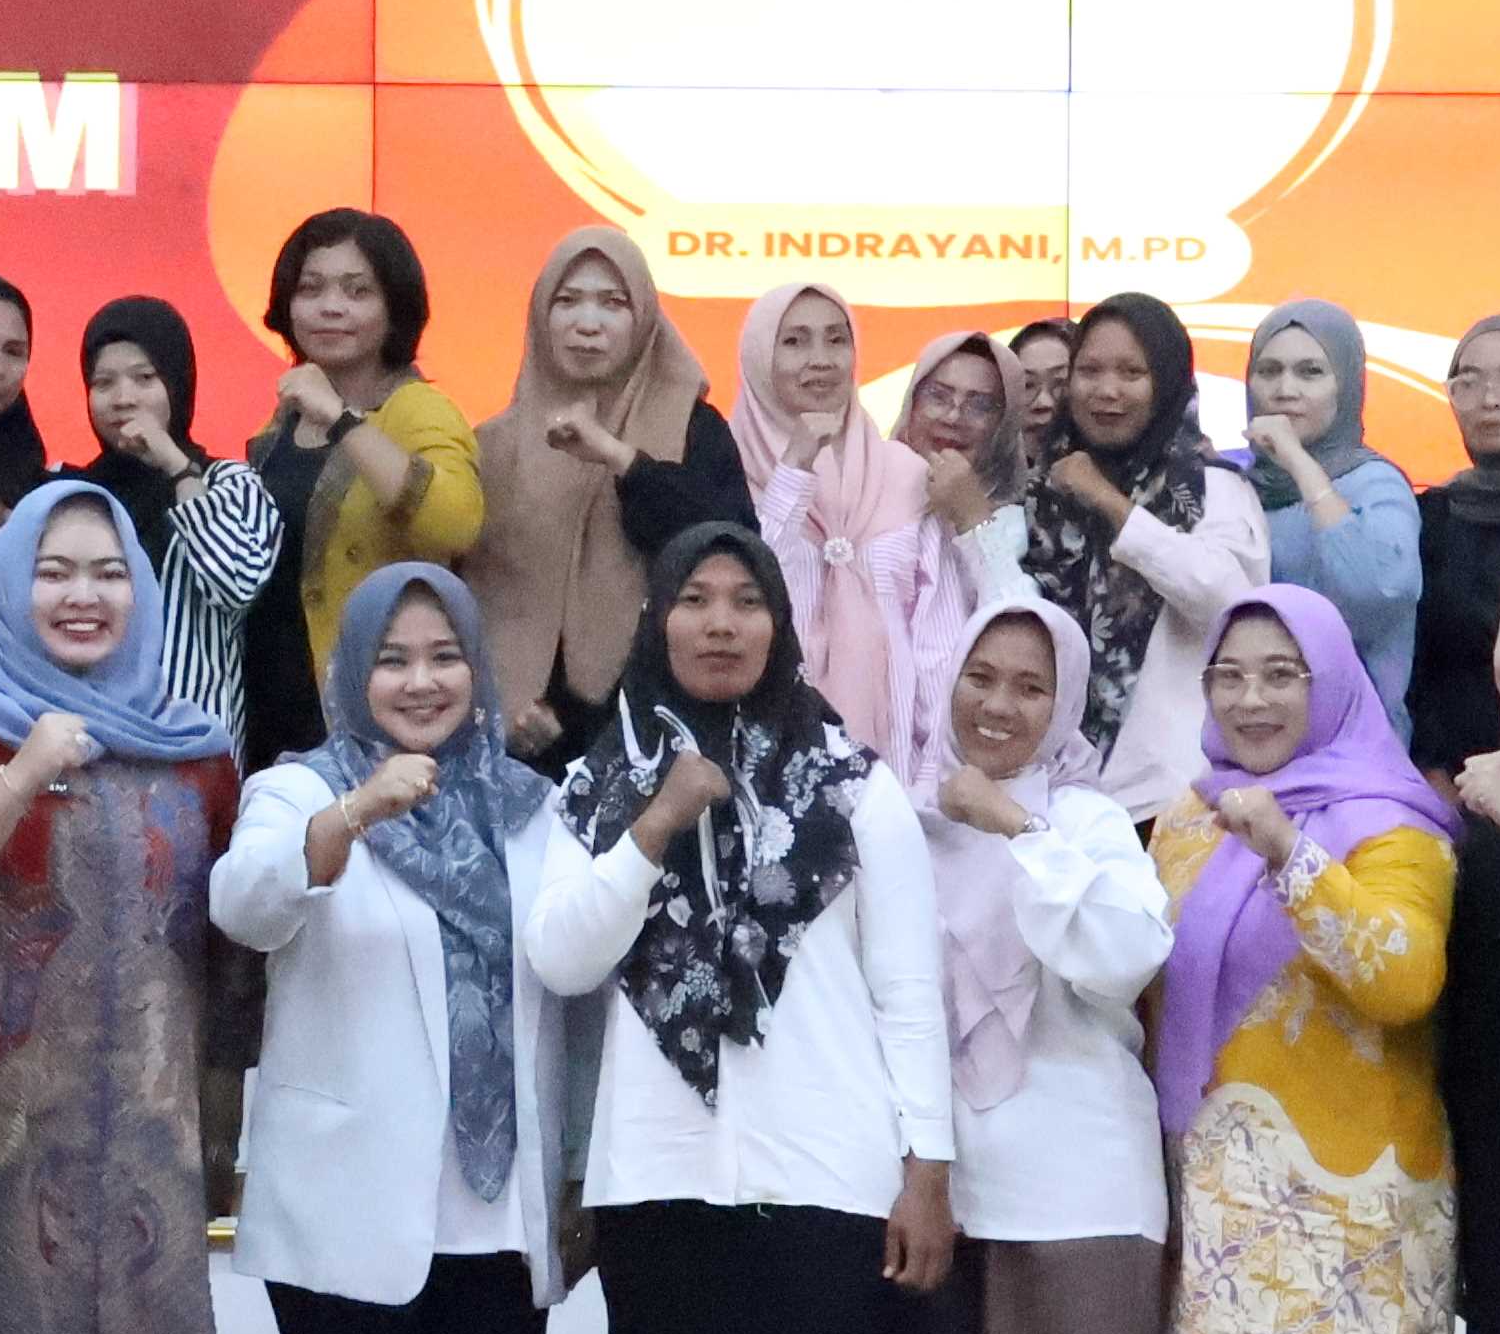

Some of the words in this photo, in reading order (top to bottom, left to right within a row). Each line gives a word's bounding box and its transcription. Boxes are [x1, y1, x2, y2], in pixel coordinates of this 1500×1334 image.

[667, 231, 749, 257] DR.
[764, 231, 1063, 264] INDRAYANI,
[1082, 236, 1207, 262] M.PD
